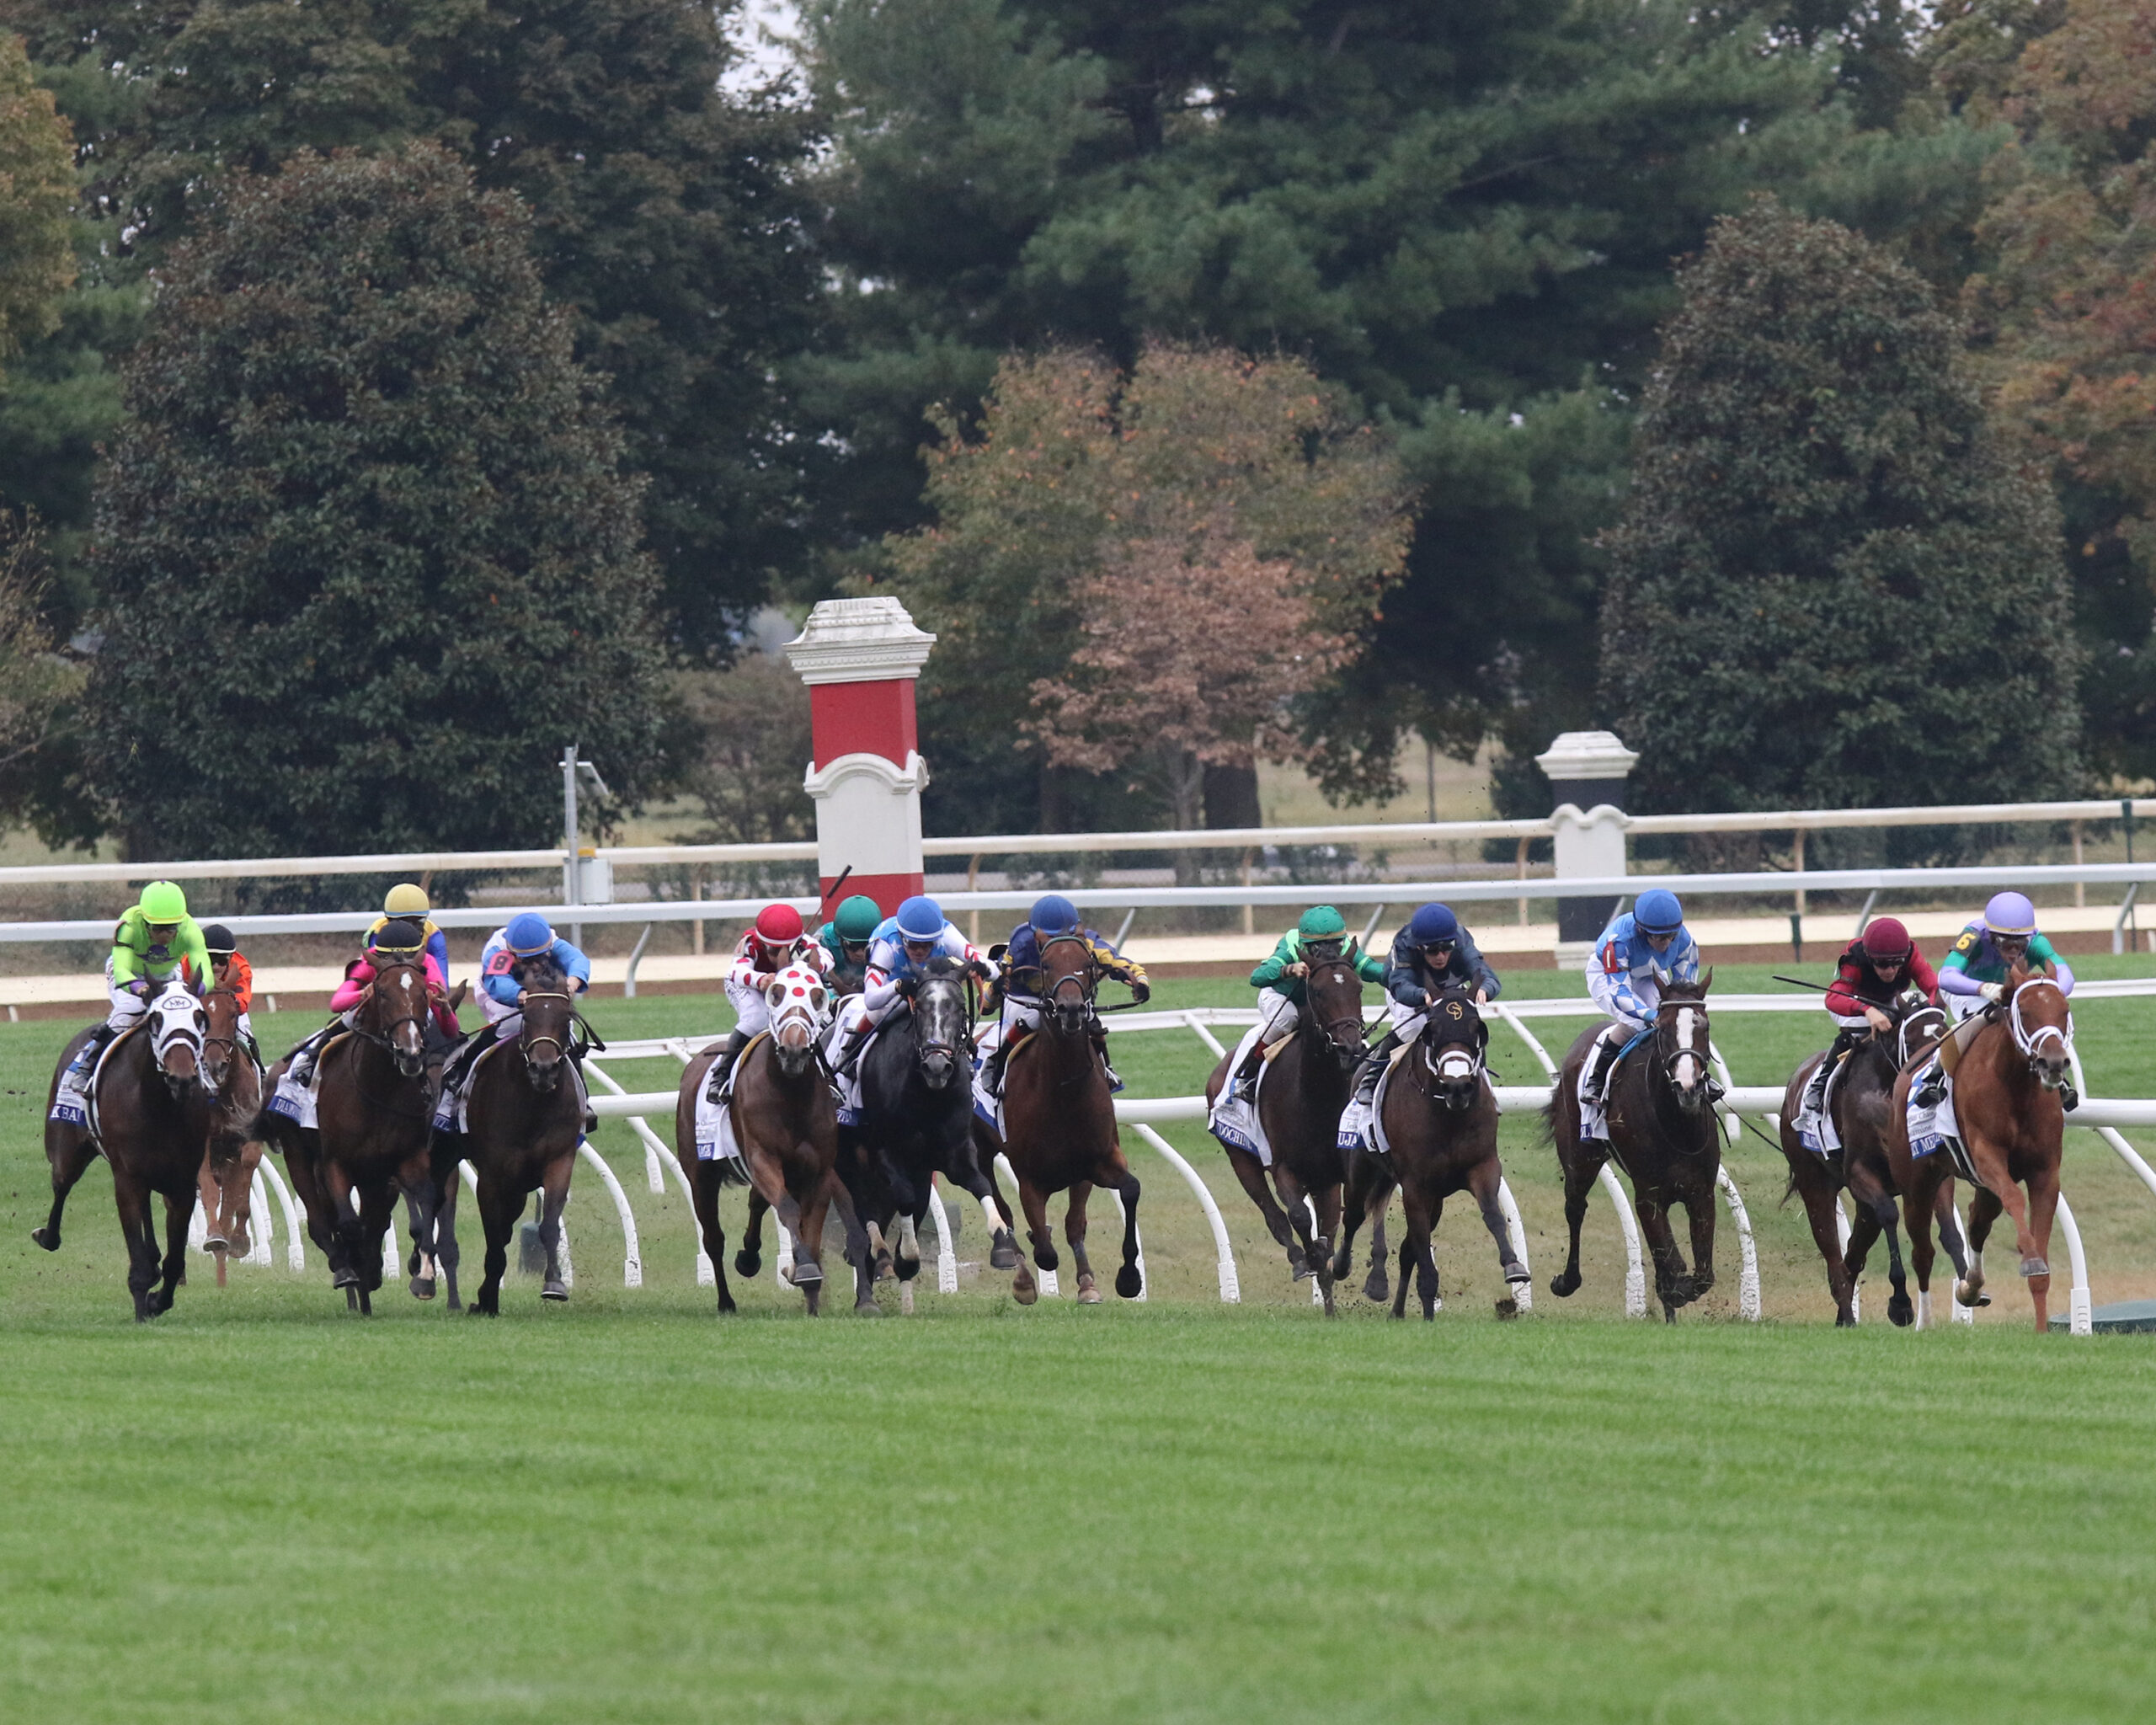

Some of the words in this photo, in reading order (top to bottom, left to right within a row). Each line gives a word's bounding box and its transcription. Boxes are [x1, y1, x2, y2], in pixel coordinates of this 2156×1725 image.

[1956, 932, 1977, 950] 6
[493, 955, 510, 971] 8
[1606, 949, 1611, 969] 1
